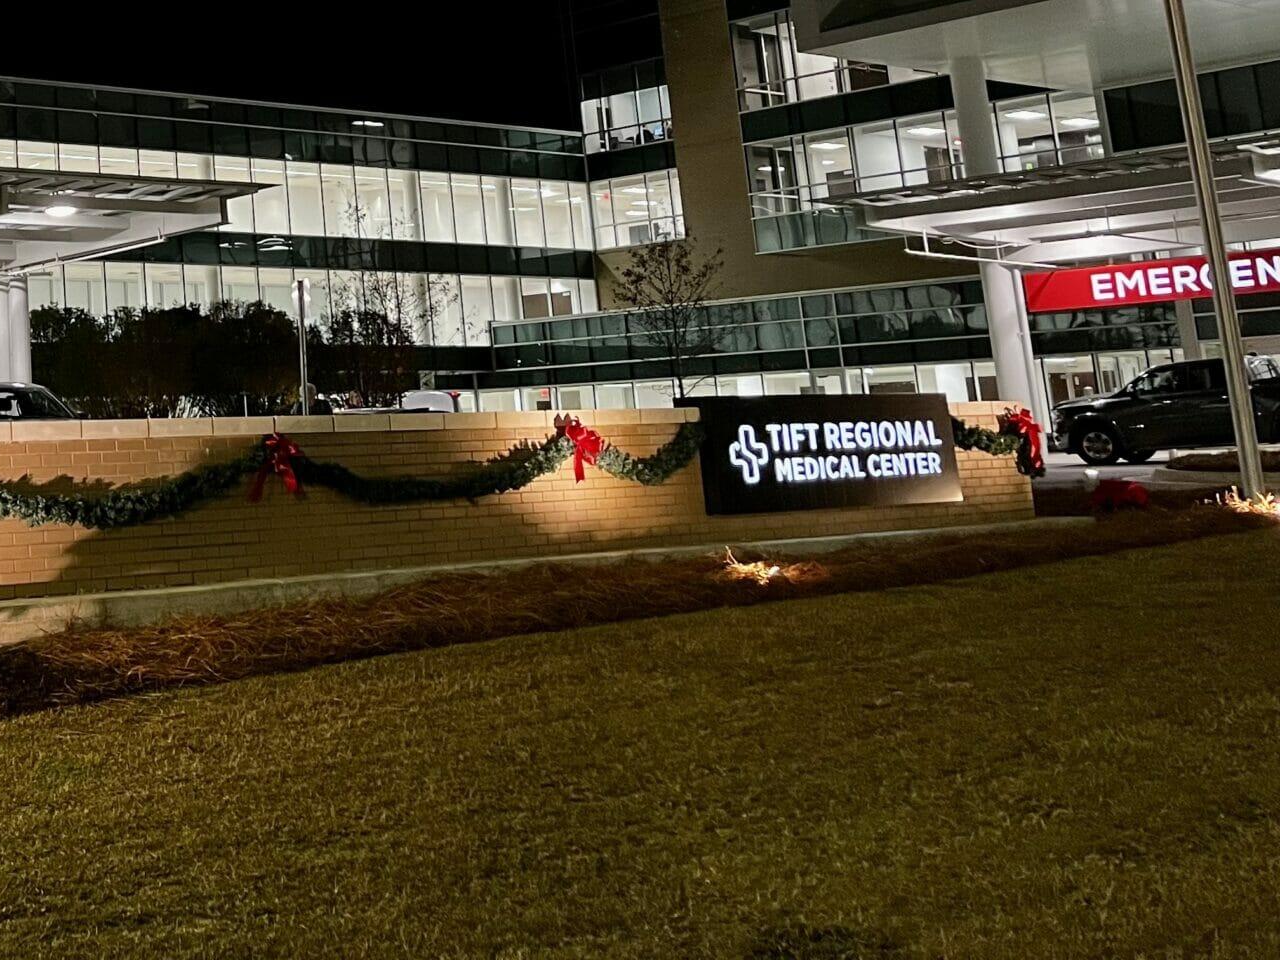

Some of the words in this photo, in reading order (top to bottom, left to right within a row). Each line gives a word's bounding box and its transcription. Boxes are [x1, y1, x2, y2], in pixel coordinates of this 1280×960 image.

[765, 422, 819, 452] TIFT
[823, 419, 943, 450] REGIONAL
[774, 455, 866, 483] MEDICAL
[867, 451, 942, 478] CENTER
